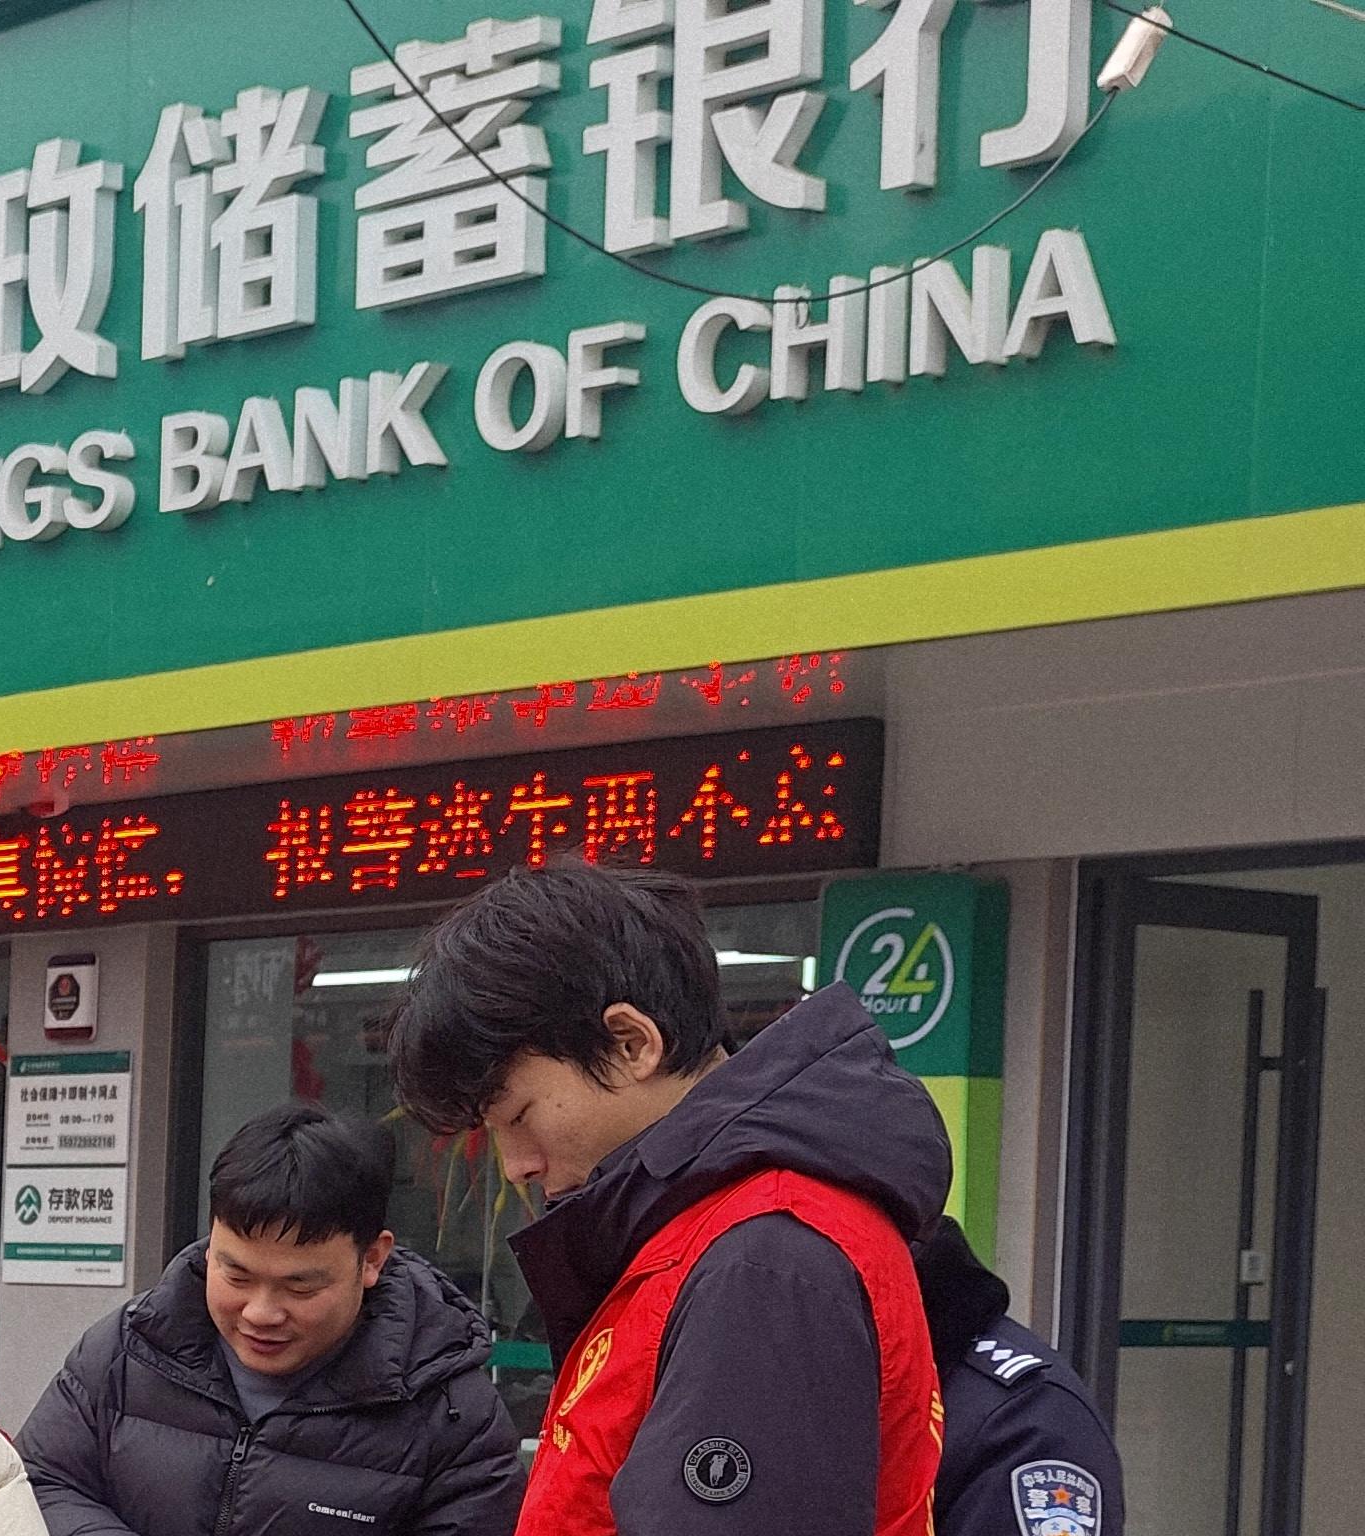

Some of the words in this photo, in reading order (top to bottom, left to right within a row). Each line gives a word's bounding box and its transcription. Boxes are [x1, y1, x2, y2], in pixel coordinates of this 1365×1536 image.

[156, 362, 450, 516] BANK
[472, 320, 649, 456] OF
[675, 228, 1116, 416] CHINA
[863, 922, 936, 1012] 24
[48, 1187, 114, 1211] 存款保险
[689, 1441, 726, 1464] CLASSIC
[727, 1444, 747, 1470] STYLE
[308, 1502, 335, 1516] Come
[353, 1512, 376, 1524] start
